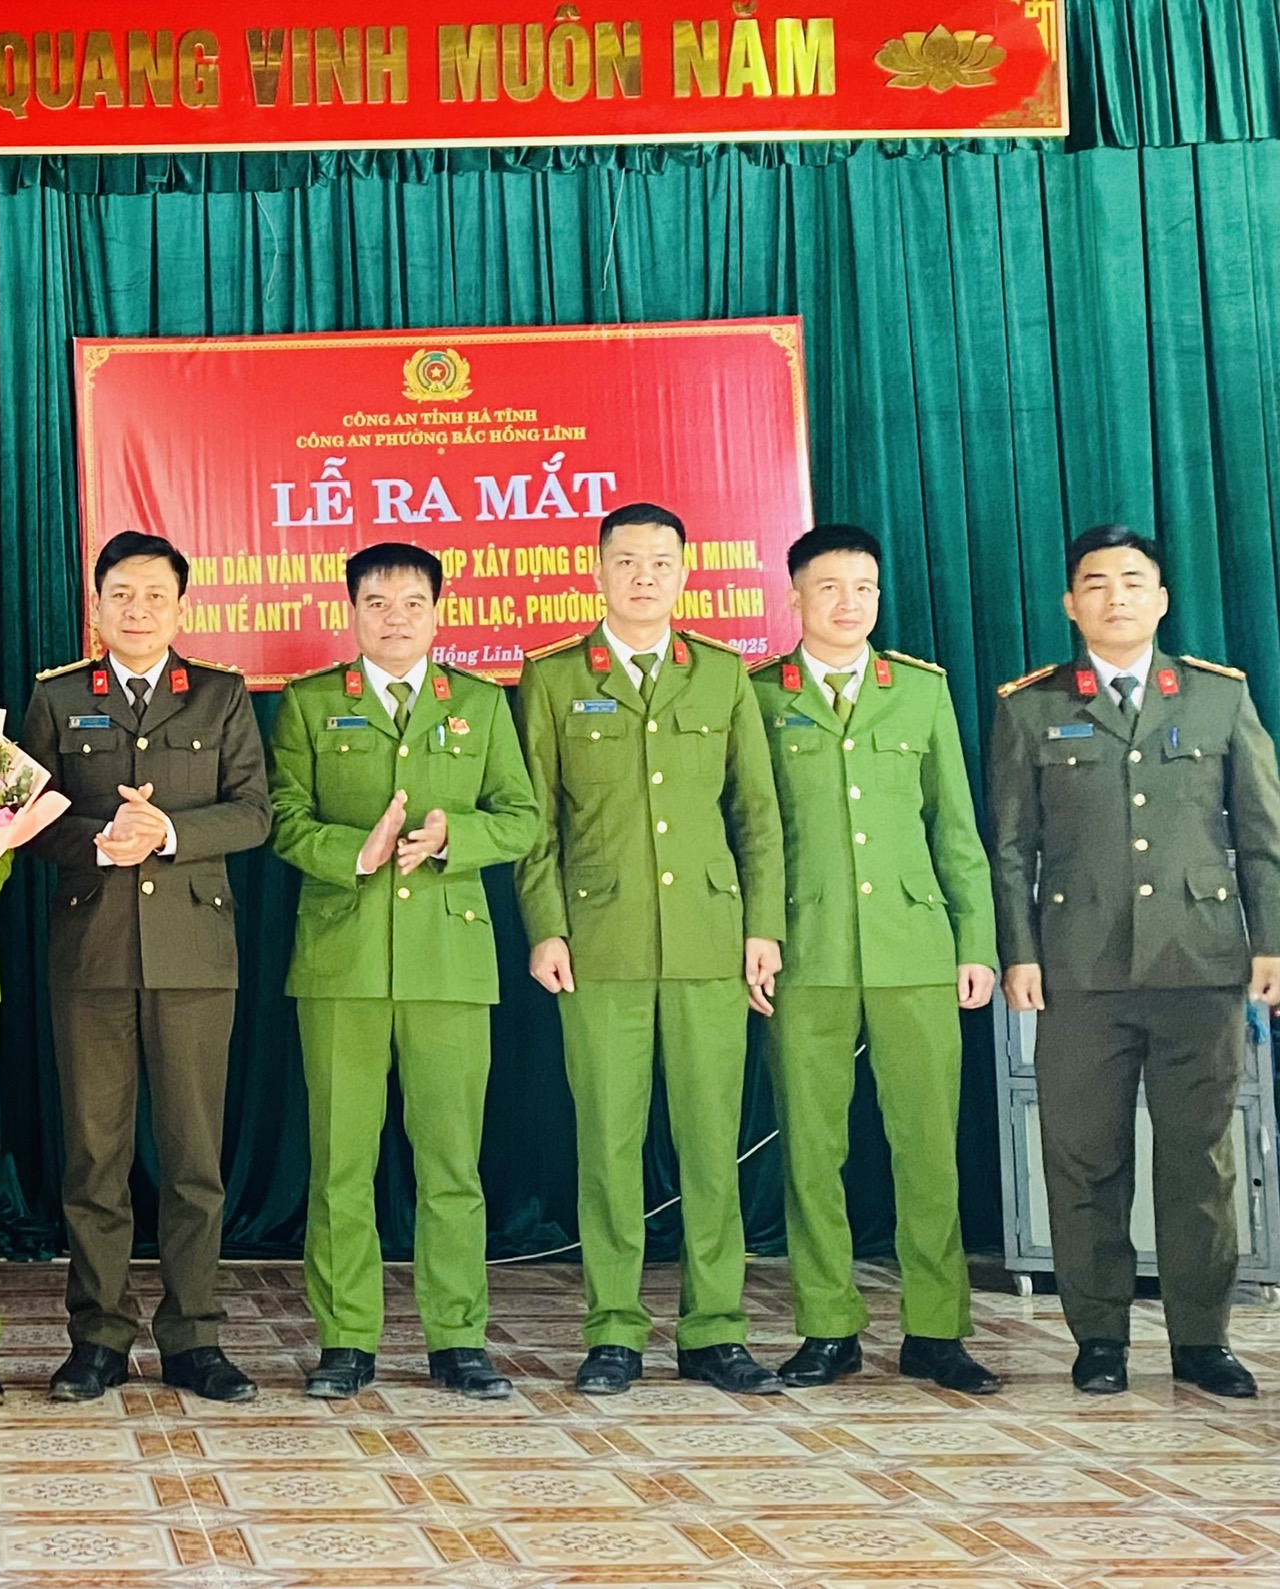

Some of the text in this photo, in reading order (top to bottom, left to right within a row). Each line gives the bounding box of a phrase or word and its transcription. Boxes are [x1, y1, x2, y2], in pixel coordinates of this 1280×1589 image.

[246, 25, 408, 107] VINH
[438, 3, 642, 102] MUÔN
[672, 0, 836, 98] NĂM
[295, 424, 587, 449] CÔNG AN PHƯỜNG BẮC HỒNG LĨNH
[342, 410, 391, 427] CÔNG
[393, 412, 418, 426] AN
[420, 407, 464, 425] TỈNH
[493, 406, 538, 423] TĨNH
[270, 450, 617, 528] LỄ RA MẮT
[222, 550, 262, 585] DÂN
[266, 548, 306, 590] VẬN
[310, 546, 355, 583] KHÉ
[428, 546, 468, 586] ỢP
[472, 542, 511, 577] XÂY
[515, 544, 570, 584] DỰNG
[574, 545, 600, 576] GI
[701, 541, 763, 572] MINH,
[317, 600, 349, 637] TẠI
[478, 595, 523, 632] LẠC,
[526, 586, 608, 625] PHƯỜNG
[717, 582, 765, 619] LĨNH
[431, 643, 480, 666] Hồng
[481, 644, 524, 662] Lĩnh
